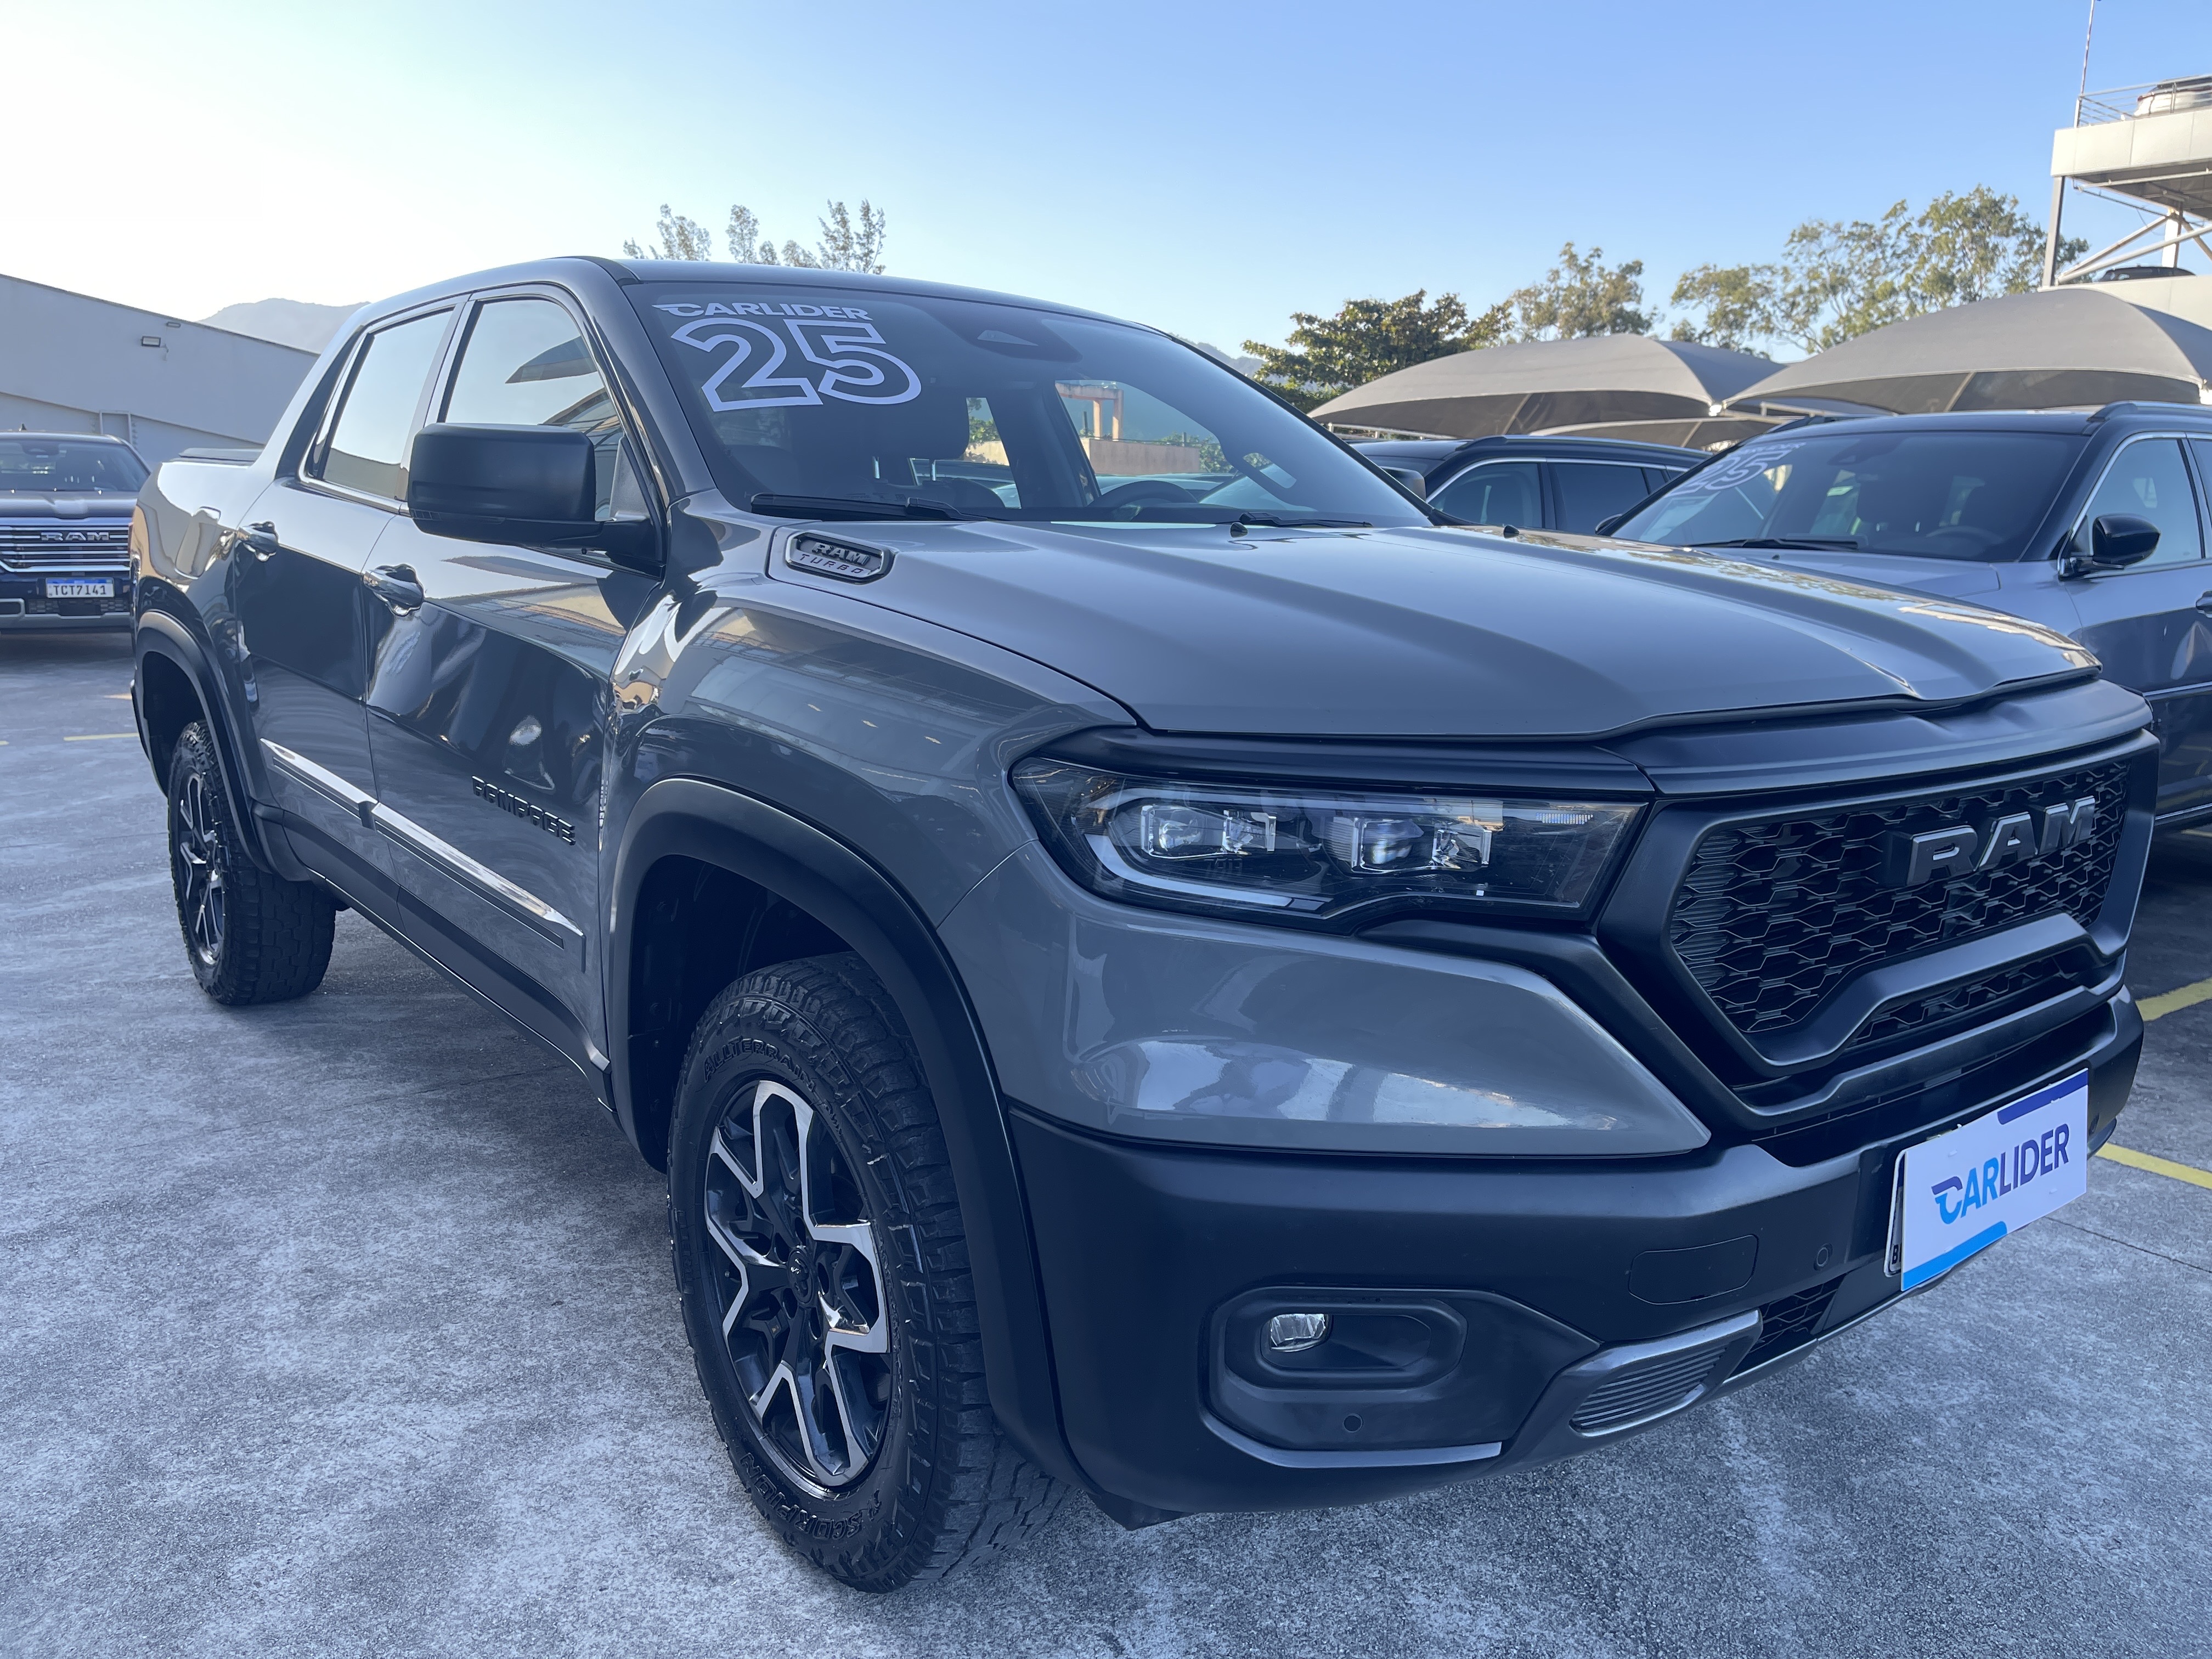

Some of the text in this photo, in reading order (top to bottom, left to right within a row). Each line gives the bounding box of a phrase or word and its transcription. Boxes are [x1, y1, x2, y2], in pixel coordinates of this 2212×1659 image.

[652, 302, 873, 320] CARLIDER
[671, 317, 922, 411] 25
[41, 532, 109, 541] RAM
[799, 554, 864, 574] TURBO
[811, 542, 871, 566] RAM
[472, 775, 576, 846] RAMPAGE
[1906, 795, 2096, 887] RAM
[1931, 1123, 2069, 1224] CARLIDER
[738, 1452, 863, 1541] SCORPION
